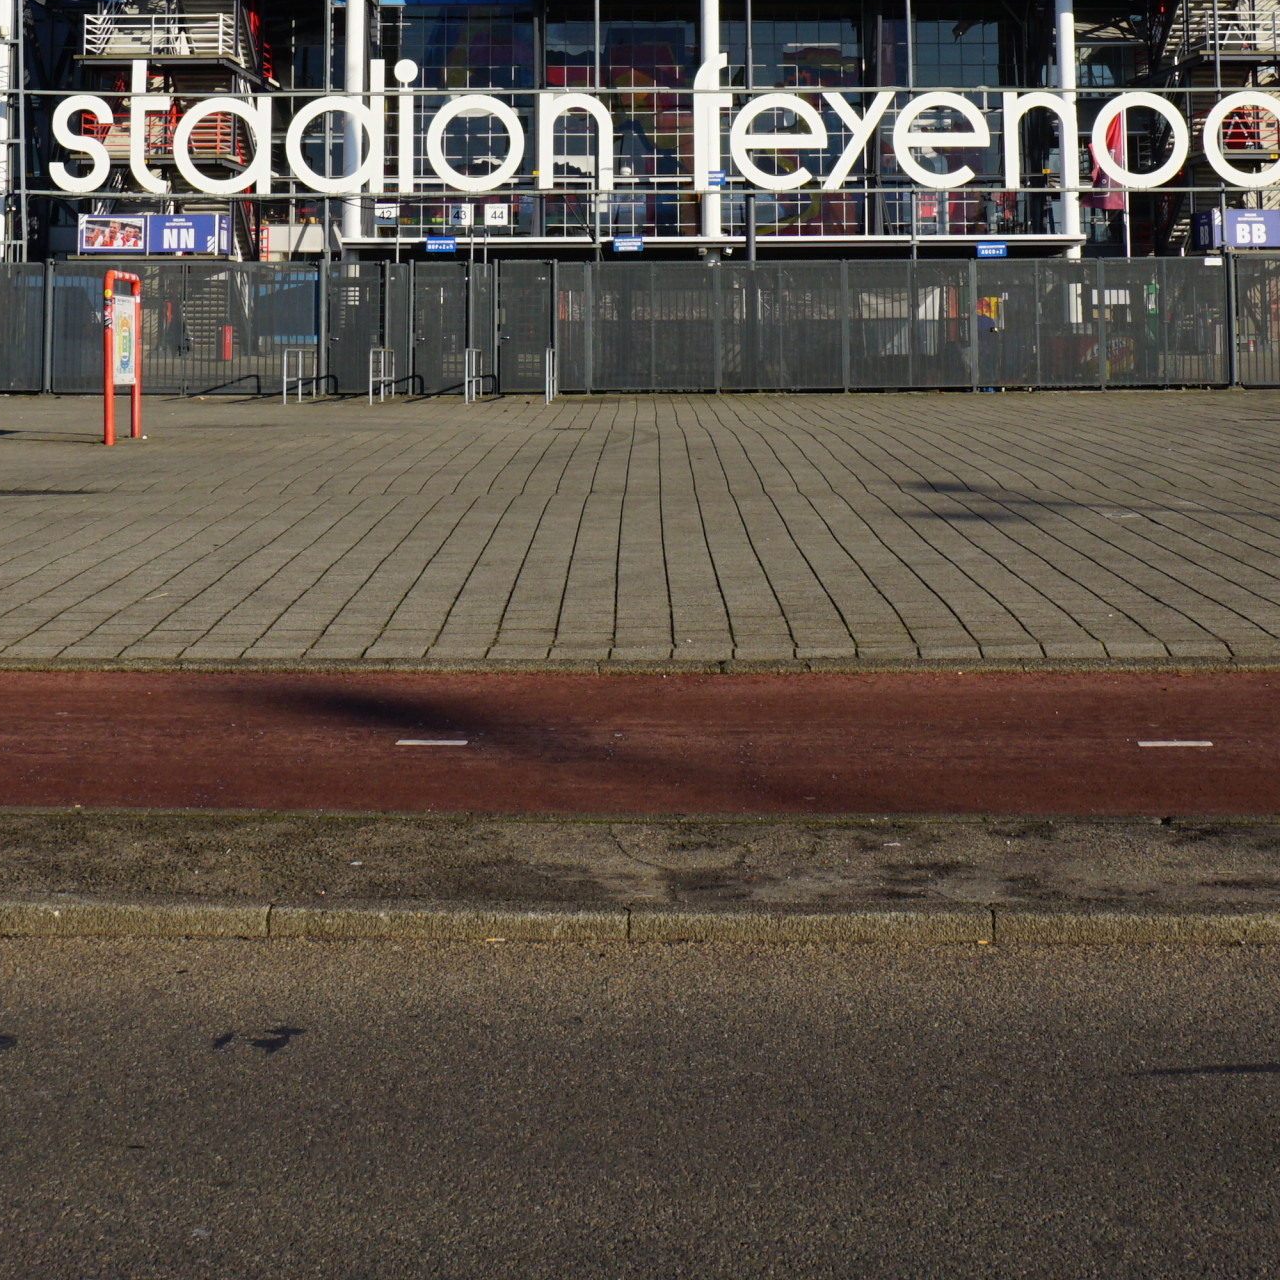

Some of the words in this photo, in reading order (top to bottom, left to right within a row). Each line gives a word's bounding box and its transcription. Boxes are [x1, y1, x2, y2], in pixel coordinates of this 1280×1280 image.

[49, 60, 614, 194] stadion
[379, 209, 393, 220] 42
[453, 210, 467, 220] 43
[490, 210, 505, 220] 44
[163, 227, 195, 249] NN
[1235, 223, 1267, 244] BB
